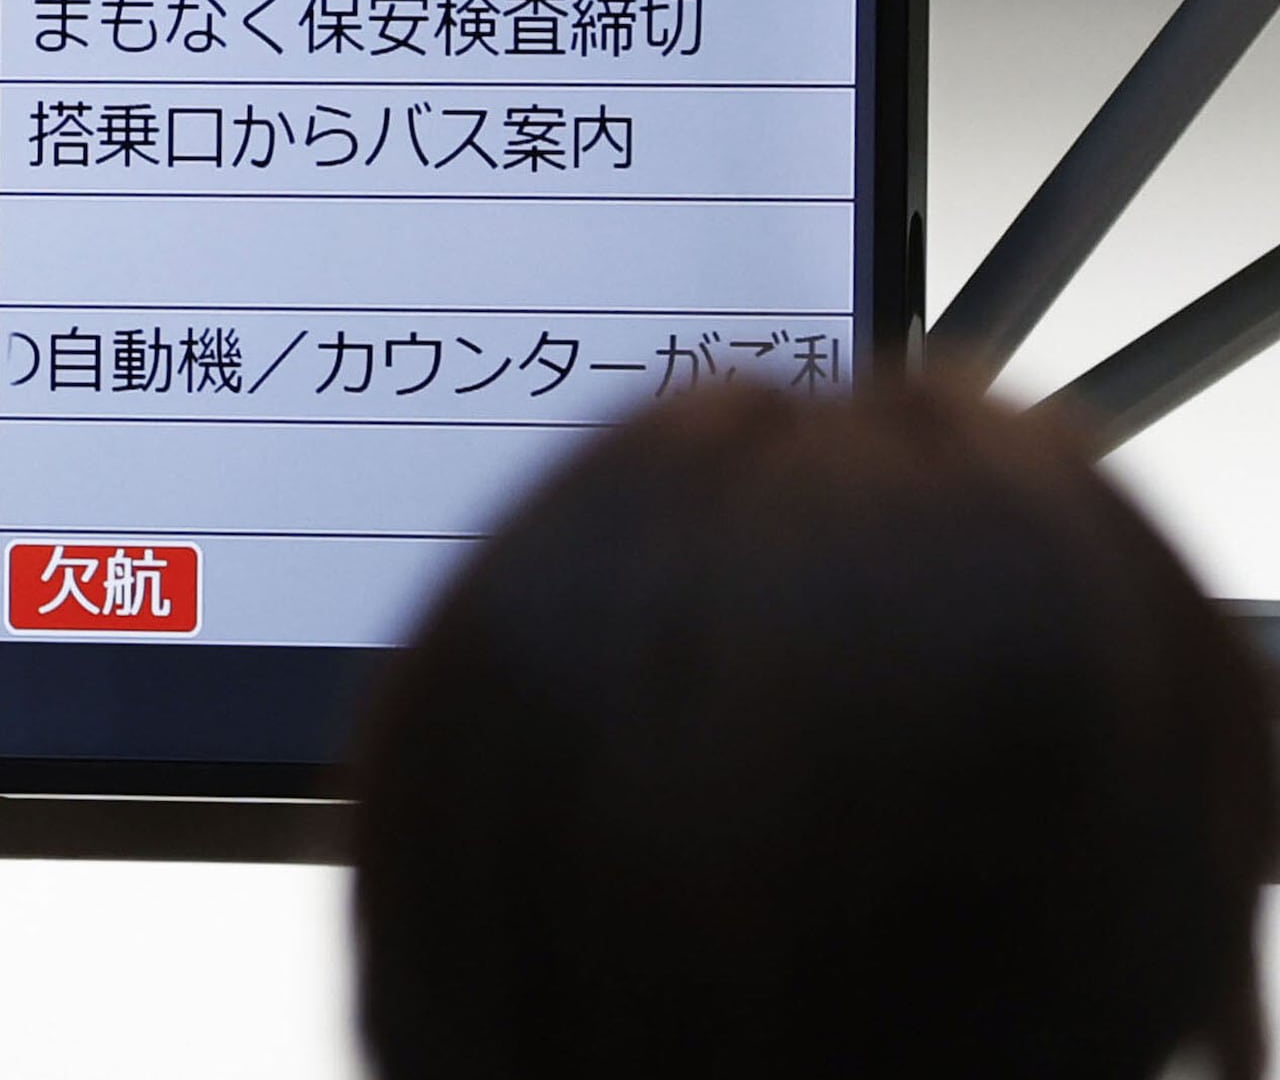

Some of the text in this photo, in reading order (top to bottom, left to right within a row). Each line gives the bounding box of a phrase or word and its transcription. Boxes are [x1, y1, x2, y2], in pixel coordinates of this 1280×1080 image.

[28, 100, 634, 172] 搭乗口からバス案内
[37, 547, 171, 617] 欠航
